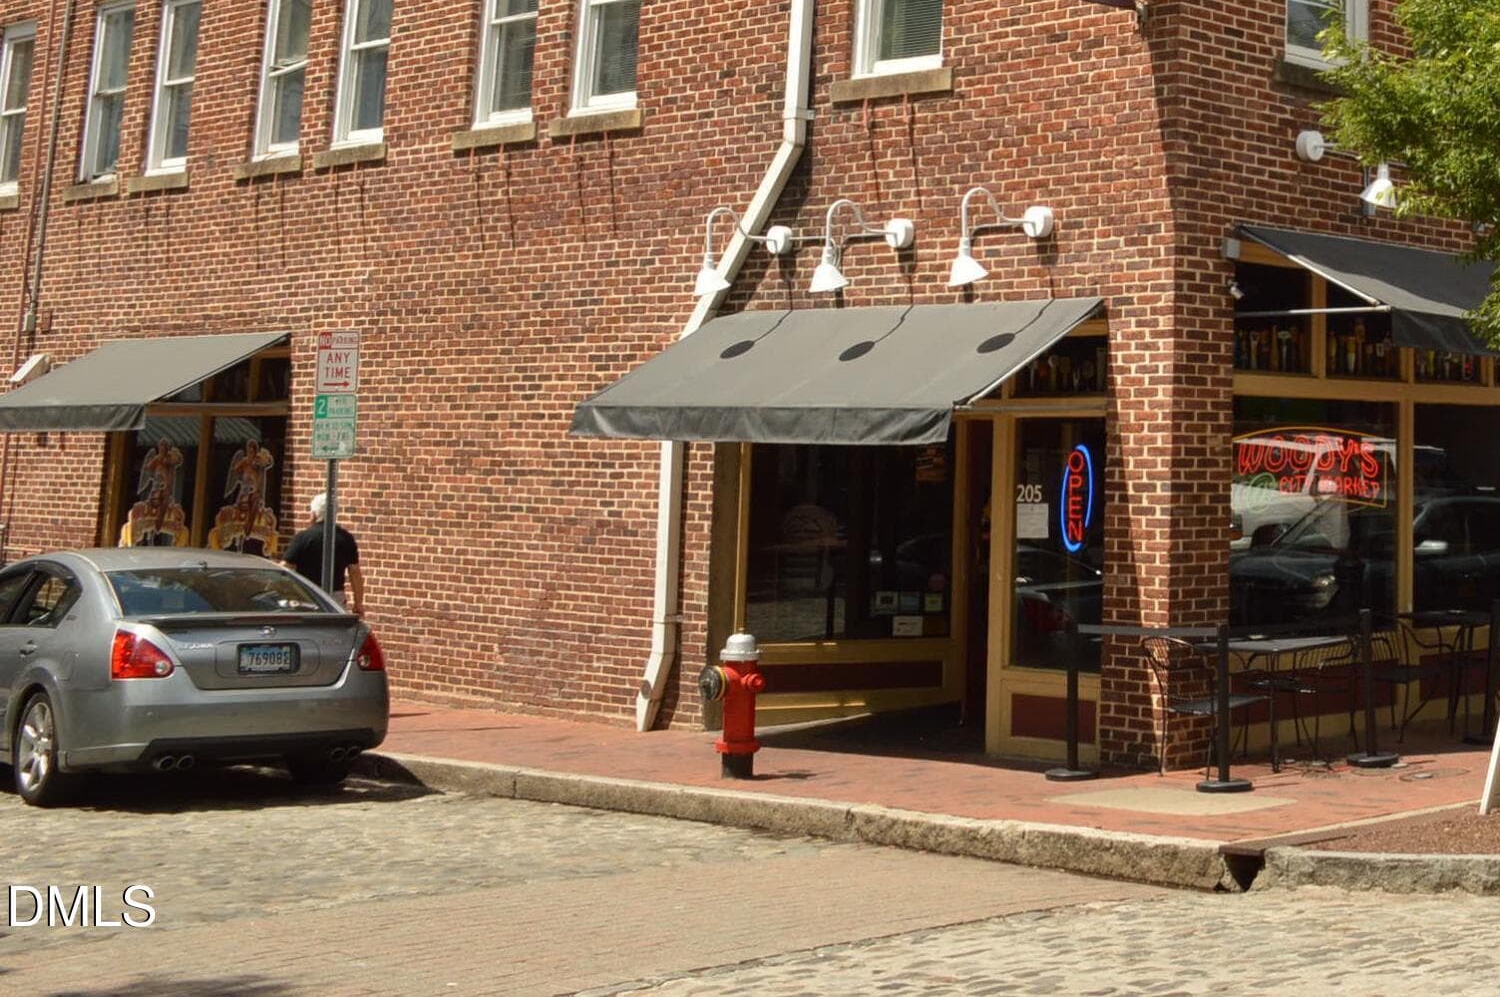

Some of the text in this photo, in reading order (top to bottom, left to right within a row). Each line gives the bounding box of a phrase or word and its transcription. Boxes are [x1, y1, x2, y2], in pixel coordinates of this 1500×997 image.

[327, 352, 350, 363] ANY
[325, 367, 351, 379] TIME
[318, 399, 326, 414] 2
[1238, 434, 1379, 478] WOODY'S
[1016, 485, 1042, 502] 205
[1067, 451, 1085, 542] OPEN
